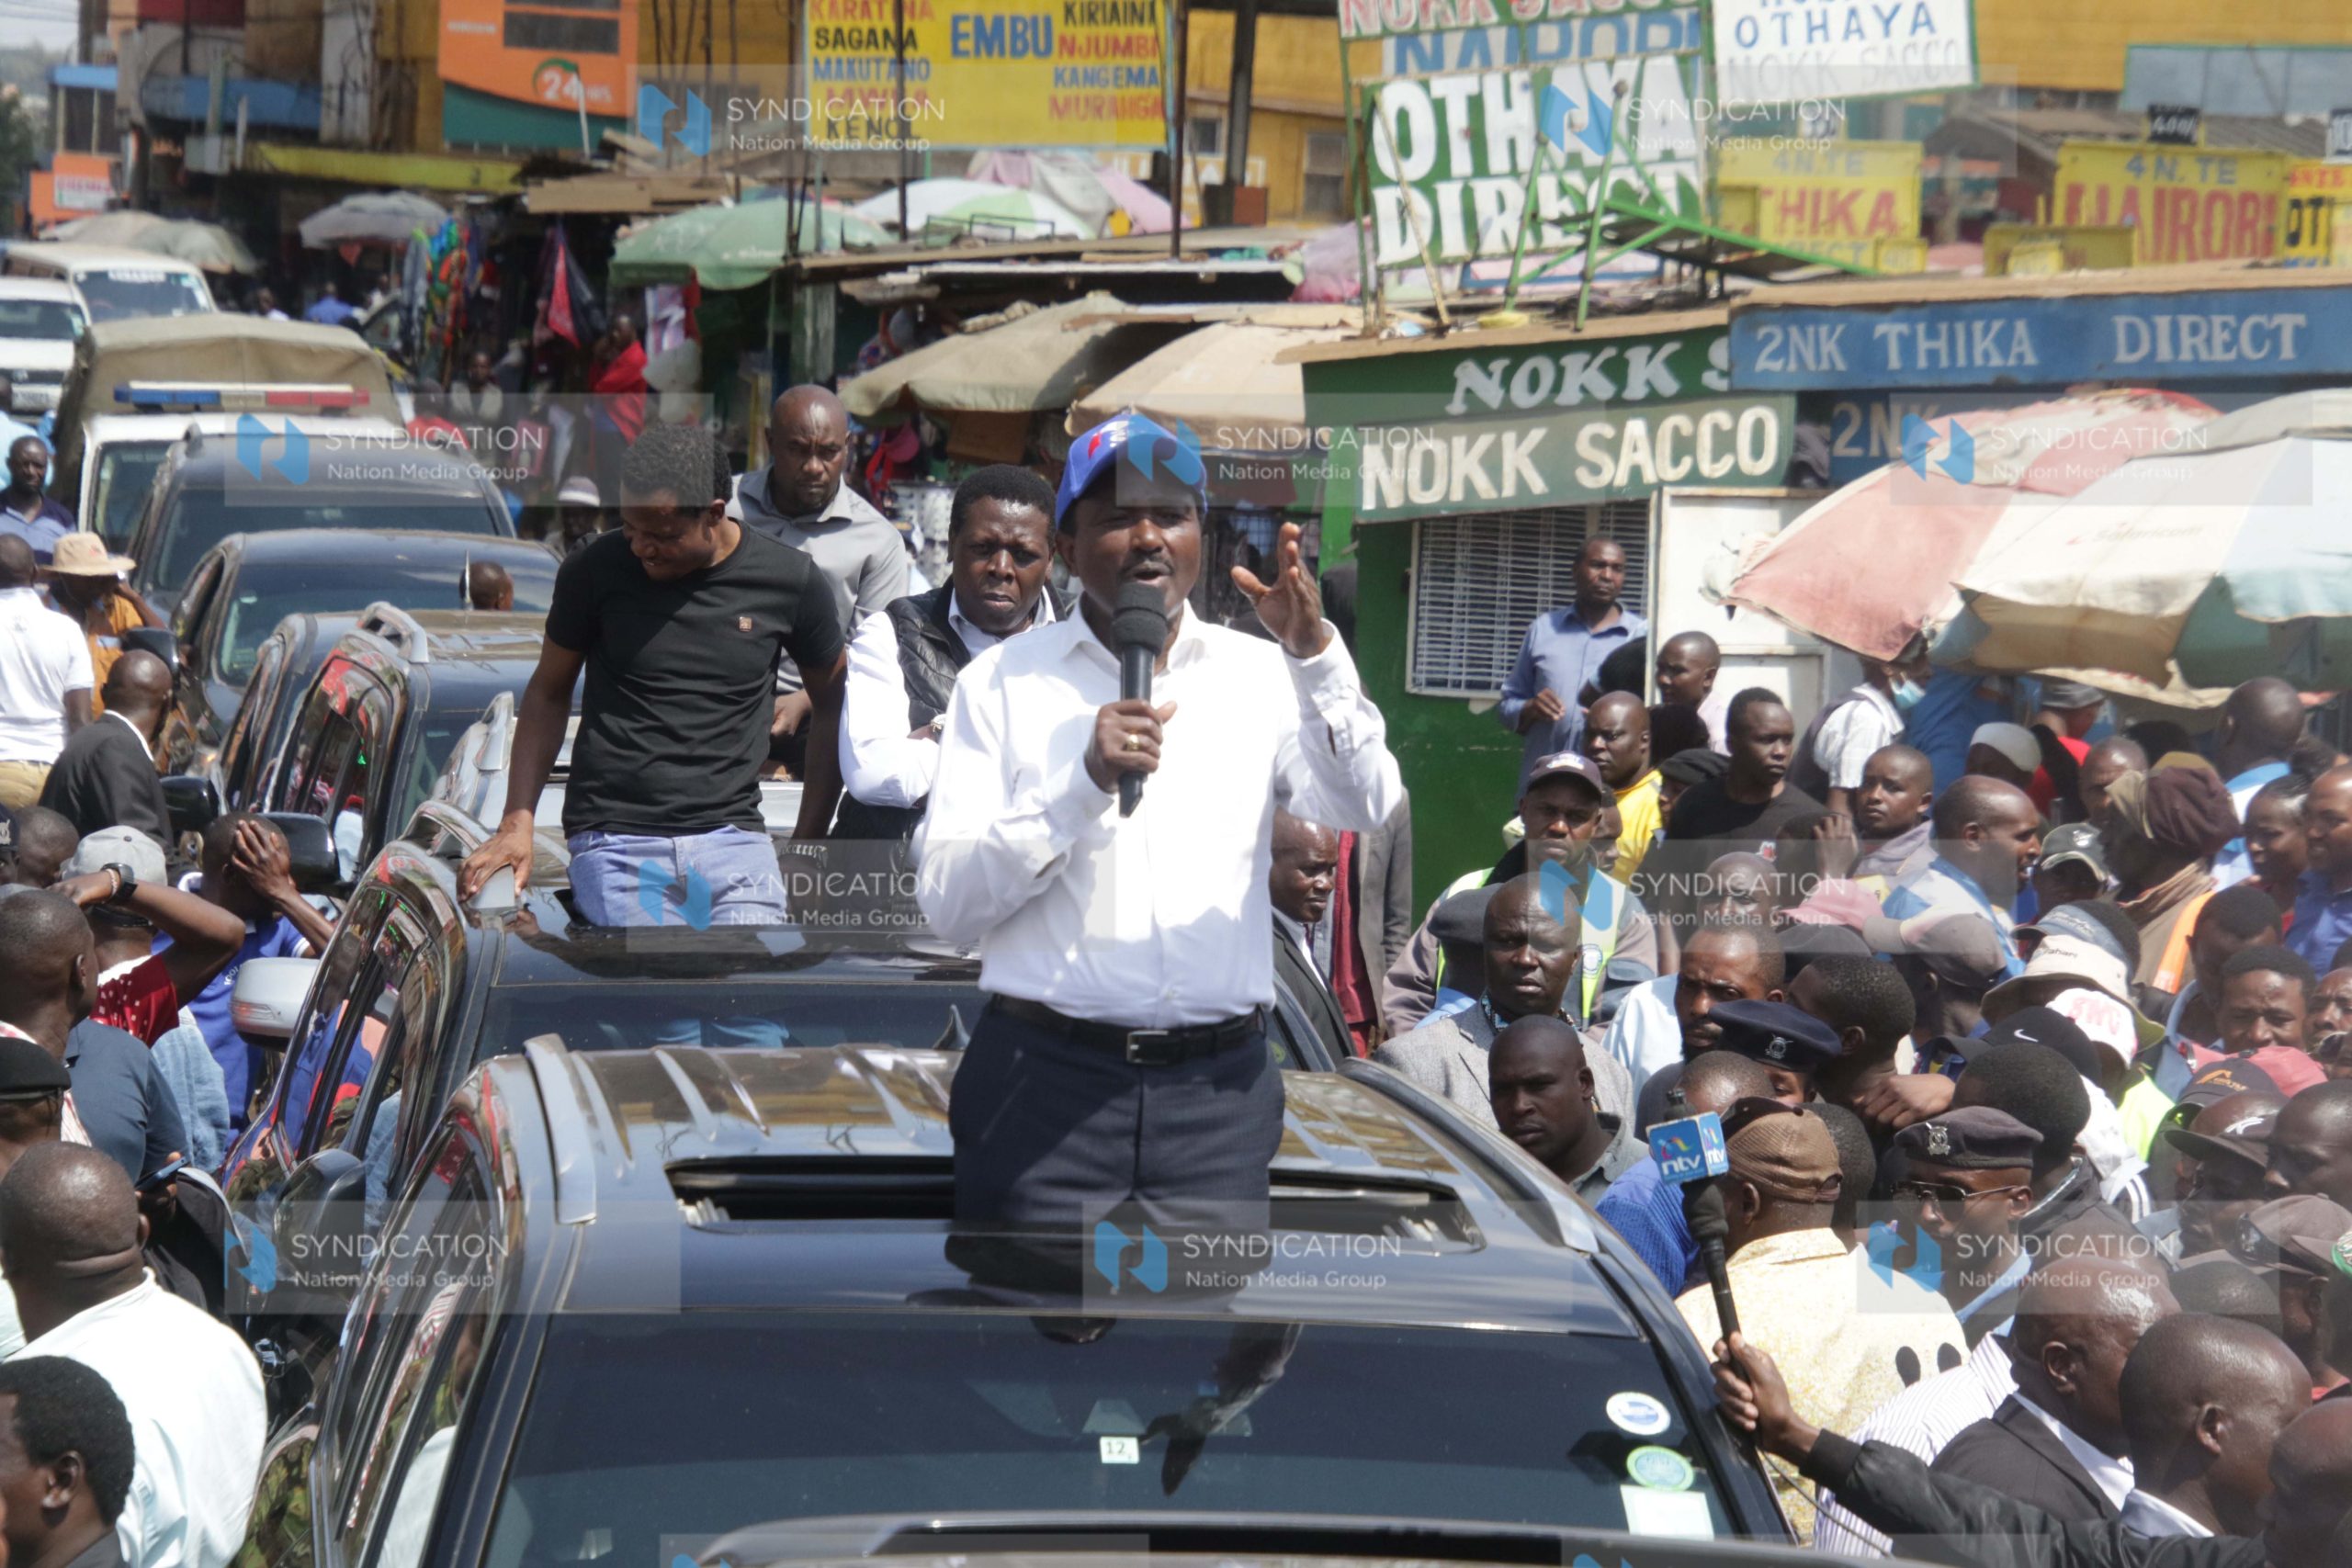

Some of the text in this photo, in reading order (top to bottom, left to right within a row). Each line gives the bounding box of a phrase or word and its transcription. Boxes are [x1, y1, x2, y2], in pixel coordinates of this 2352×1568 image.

[814, 27, 918, 51] SAGANA
[951, 14, 1054, 59] EMBU
[1735, 1, 1937, 49] OTHAYA
[542, 70, 582, 101] 24
[812, 56, 932, 81] MAKUTANO
[1054, 65, 1159, 88] KANGEMA
[1727, 39, 1961, 95] NOKK SACCO
[1373, 55, 1698, 183] OTHAYA
[1753, 312, 2309, 372] 2NK THIKA DIRECT
[1444, 341, 1683, 416] NOKK
[1361, 405, 1781, 512] NOKK SACCO
[1660, 1154, 1701, 1176] ntv
